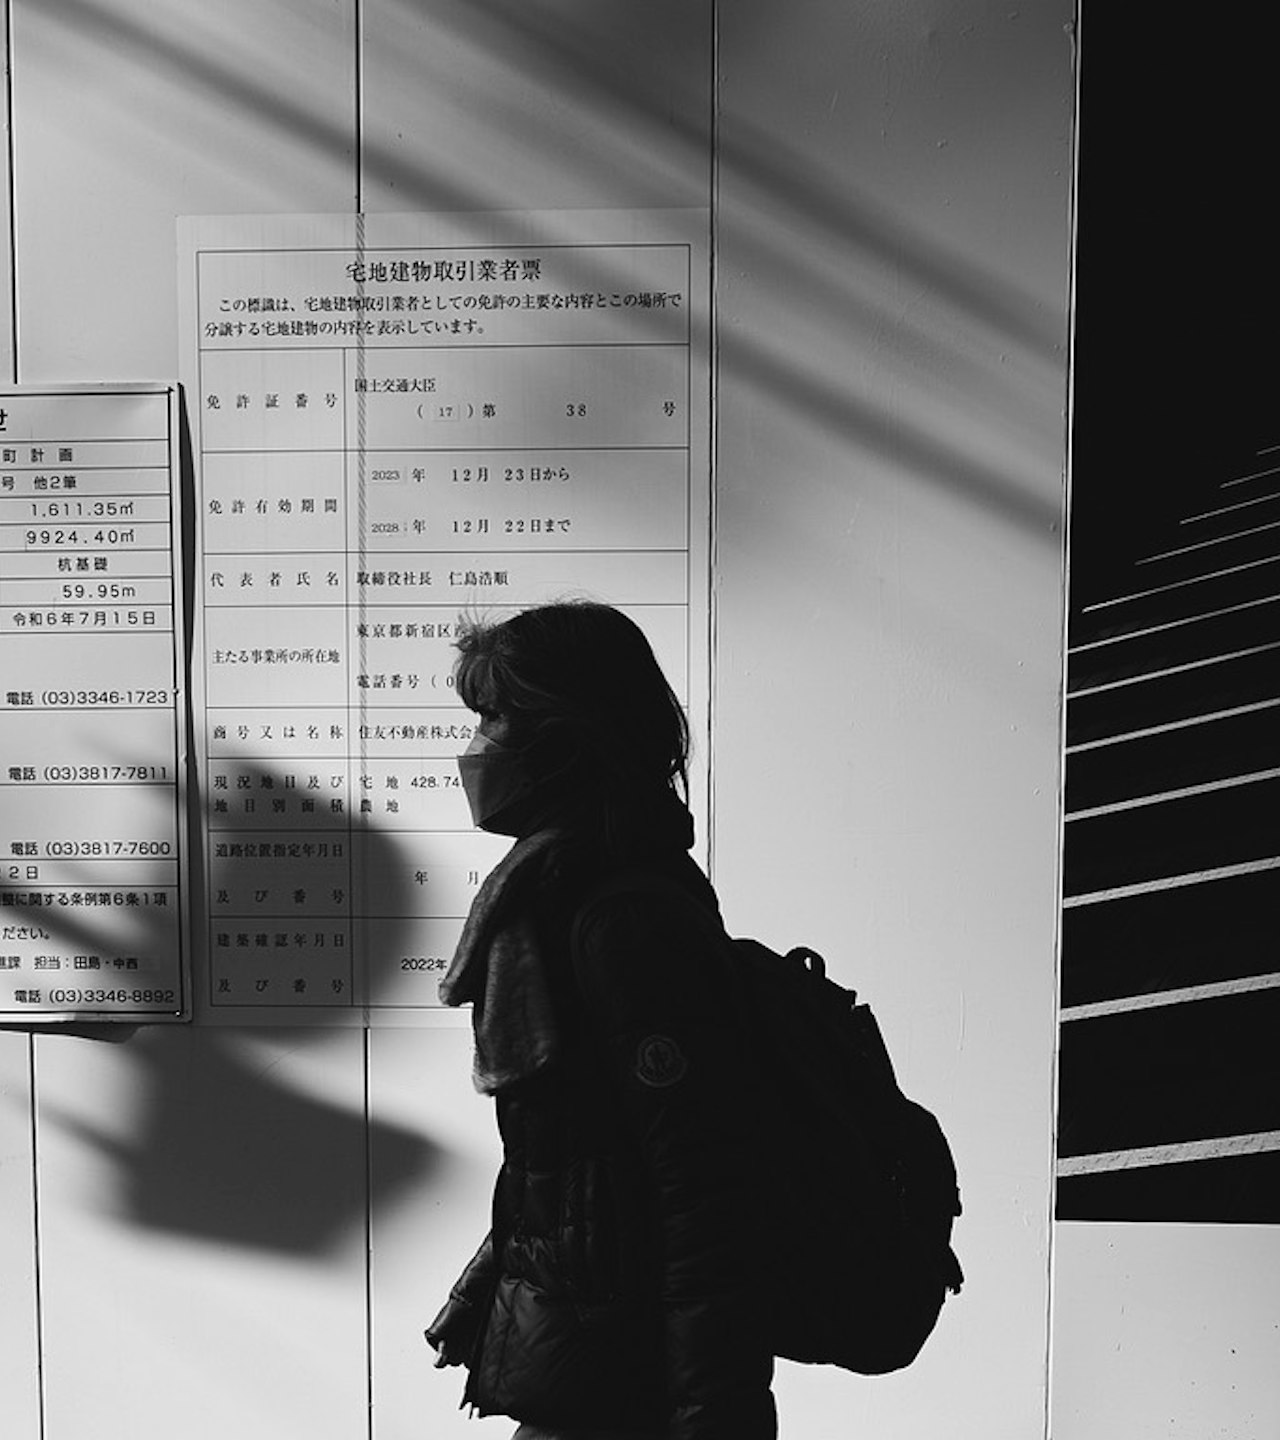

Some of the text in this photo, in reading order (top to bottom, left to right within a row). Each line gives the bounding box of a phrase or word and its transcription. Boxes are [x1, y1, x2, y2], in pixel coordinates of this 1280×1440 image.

[346, 258, 541, 283] 宅地建物取引業者票
[219, 292, 683, 313] この標識は、宅地建物取引業者としての免許の主要な内容とこの場所で
[205, 318, 485, 337] 分譲する宅地建物の内容を表示しています。
[354, 377, 436, 393] 国土交通大臣
[207, 393, 338, 409] 免許証番号
[566, 401, 676, 418] 38 号
[452, 467, 571, 482] 12月 23日から
[34, 476, 77, 490] 他2筆
[208, 499, 337, 514] 免許有効期間
[452, 519, 571, 533] 12月 22日まで
[58, 556, 108, 572] 杭基礎
[211, 571, 339, 587] 代表者氏名
[356, 570, 432, 586] 取締役社長
[62, 584, 136, 599] 59.95m
[13, 611, 156, 627] 令和6年7月15日
[212, 648, 340, 664] 主たる事業所の所在地
[6, 691, 168, 706] 電話 (03)3346-1723
[213, 725, 344, 741] 商号又は名称
[8, 766, 167, 781] 電話 (03)3817-7811
[214, 775, 344, 791] 現況地目及び
[359, 775, 399, 789] 宅地
[214, 798, 343, 813] 地目別面積
[11, 841, 170, 857] 電話 (03)3817-7600
[215, 842, 343, 858] 道路位置指定年月日
[415, 870, 428, 884] 年
[216, 888, 345, 904] 及び番号
[216, 933, 344, 947] 建築確認年月日
[401, 958, 447, 971] 2022年
[216, 978, 345, 994] 及び番号
[15, 989, 41, 1003] 電話
